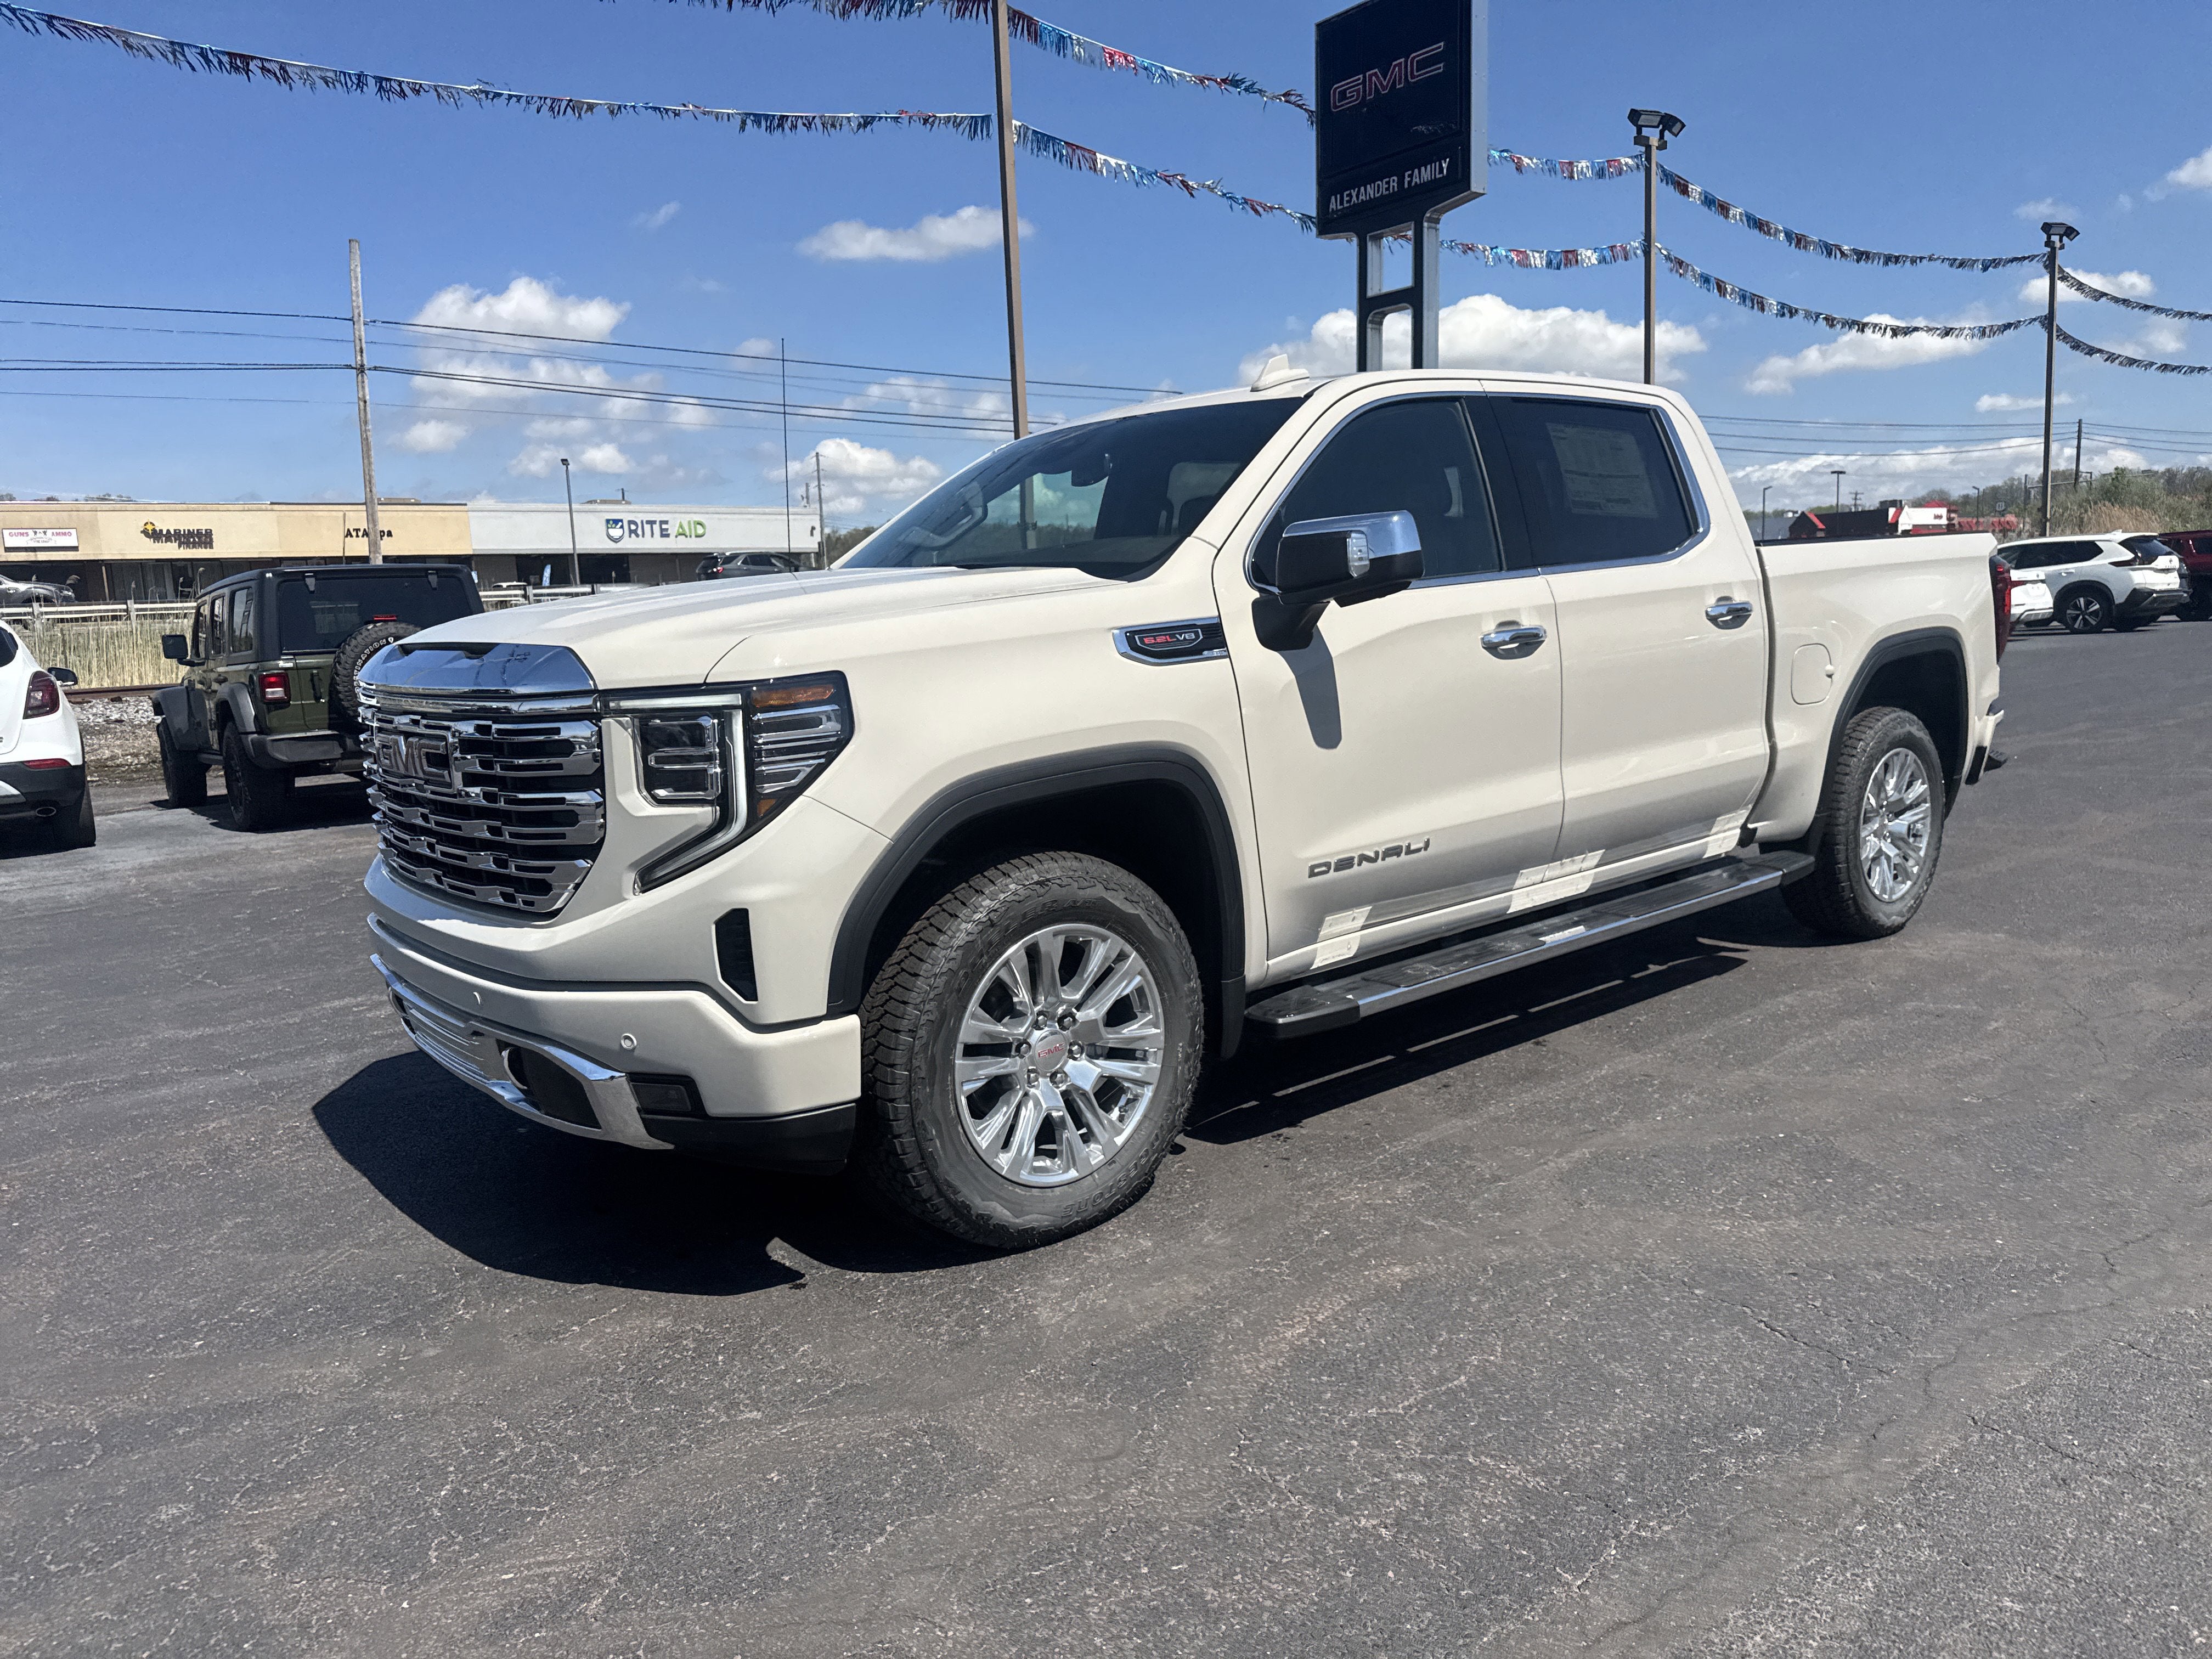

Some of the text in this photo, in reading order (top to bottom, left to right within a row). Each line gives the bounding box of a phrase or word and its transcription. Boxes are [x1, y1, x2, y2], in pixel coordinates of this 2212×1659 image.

[1331, 42, 1444, 112] GMC
[1329, 158, 1449, 212] ALEXANDER FAMILY
[628, 520, 706, 538] RITE AID
[376, 733, 451, 782] GMC
[1308, 837, 1430, 878] DENALI
[1037, 1042, 1065, 1058] GMC
